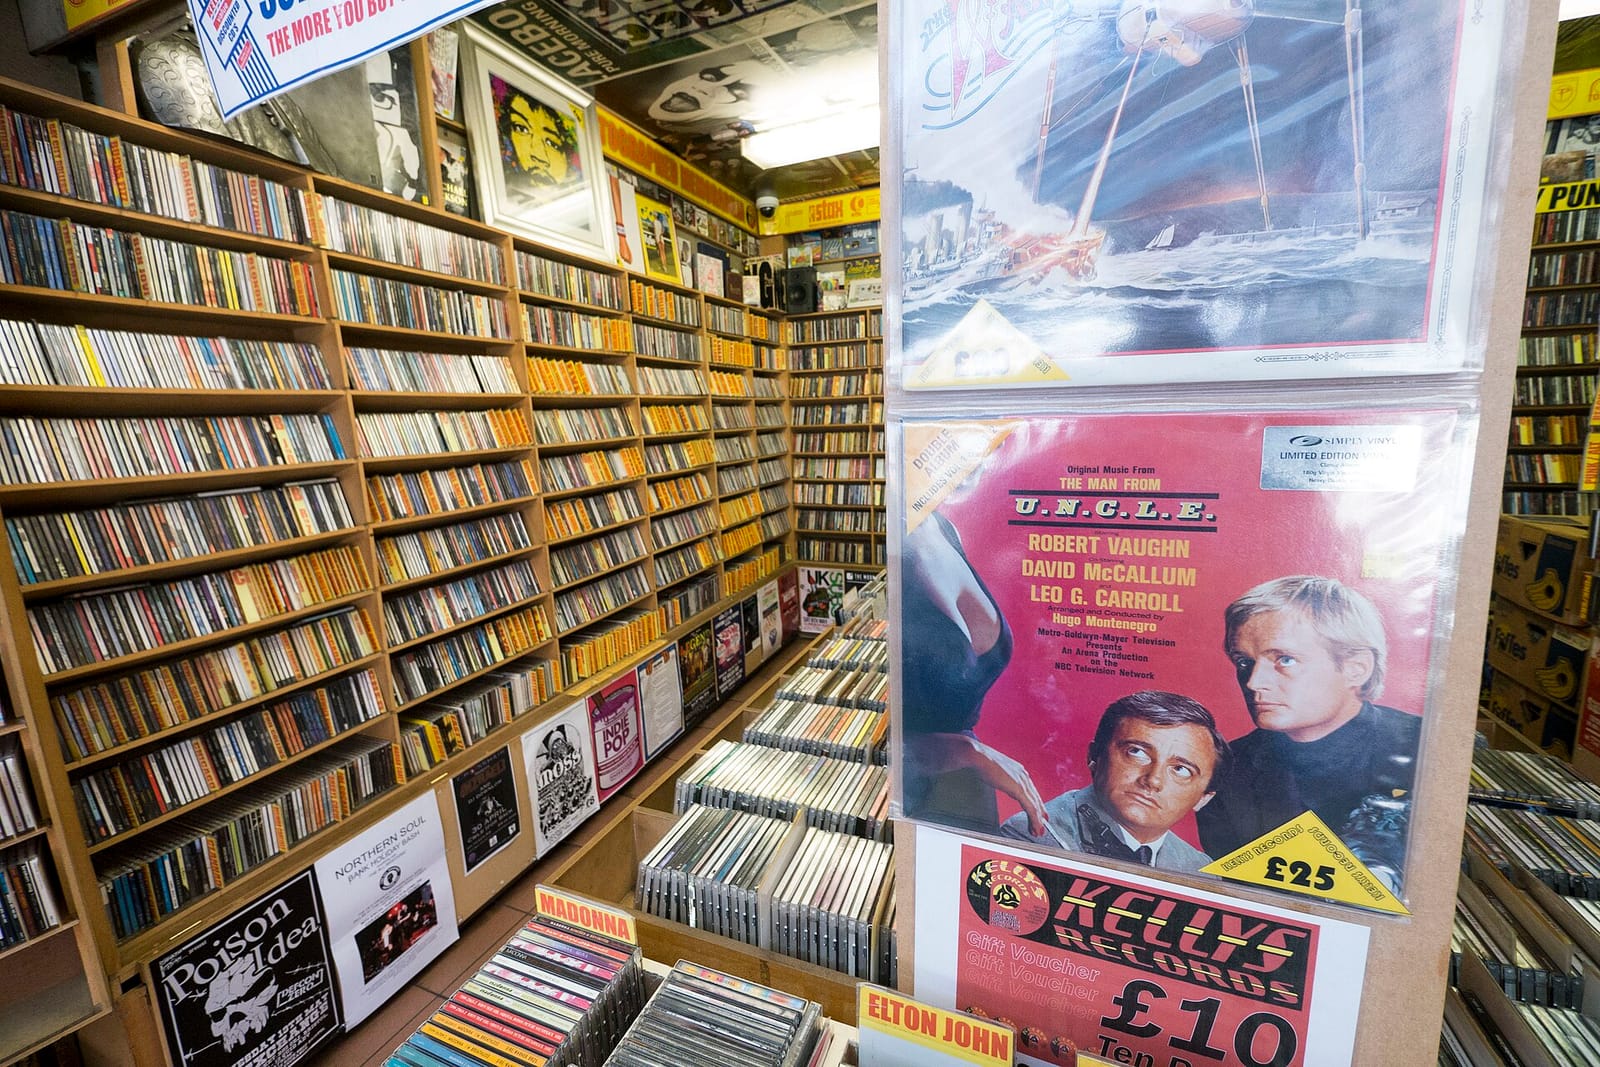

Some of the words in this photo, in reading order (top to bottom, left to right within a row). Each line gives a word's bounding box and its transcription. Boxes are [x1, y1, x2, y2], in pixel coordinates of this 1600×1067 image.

[266, 25, 291, 57] THE
[291, 8, 332, 47] MORE
[333, 0, 364, 30] YOU
[521, 1, 591, 51] MORNING
[583, 48, 620, 73] PURE
[178, 160, 199, 217] BANGLES
[246, 179, 266, 232] BOYZONE
[912, 428, 953, 470] DOUBLE
[924, 439, 961, 477] ALBUM
[1280, 452, 1317, 460] LIMITED
[1321, 452, 1359, 460] EDITION
[1059, 478, 1082, 489] THE
[1088, 478, 1117, 490] MAN
[1124, 479, 1160, 490] FROM
[1067, 466, 1099, 475] Original
[1103, 466, 1129, 474] Music
[912, 477, 948, 512] INCLUDES
[1015, 498, 1217, 521] U.N.C.L.E.
[1029, 534, 1100, 554] ROBERT
[1108, 537, 1190, 558] VAUGHN
[1022, 559, 1075, 579] DAVID
[1084, 563, 1196, 586] McCALLUM
[1031, 585, 1062, 603] LEO
[1071, 588, 1088, 605] G.
[1095, 590, 1184, 612] CARROLL
[1048, 605, 1084, 614] Arranged
[1104, 610, 1152, 618] Conducted
[1052, 613, 1081, 626] Hugo
[1086, 615, 1157, 633] Montenegro
[1076, 648, 1098, 657] Arena
[1103, 651, 1148, 662] Production
[1086, 641, 1122, 651] Presents
[1133, 636, 1176, 646] Television
[1055, 662, 1071, 670] NBC
[1075, 665, 1116, 675] Television
[1120, 669, 1154, 679] Network
[603, 714, 630, 742] INDIE
[604, 727, 631, 758] POP
[335, 833, 398, 880] NORTHERN
[399, 815, 427, 838] SOUL
[347, 864, 369, 883] BANK
[370, 843, 401, 867] HOLIDAY
[401, 830, 421, 847] BASH
[1252, 824, 1304, 856] RECORDS
[1307, 826, 1355, 872] RECORDS
[971, 861, 1047, 903] KELLYS
[985, 874, 1030, 898] RECORDS
[1263, 856, 1336, 891] £25
[539, 892, 631, 940] MADONNA
[161, 899, 293, 1005] Poison
[250, 916, 321, 972] Idea
[966, 931, 1005, 955] Gift
[1011, 944, 1100, 982] Voucher
[966, 949, 1005, 974] Gift
[1010, 962, 1099, 1001] Voucher
[1054, 924, 1298, 1004] RECORDS
[279, 972, 320, 998] DEFCON
[288, 983, 314, 1001] ZERO
[1009, 981, 1097, 1019] Voucher
[869, 993, 937, 1038] ELTON
[943, 1016, 1008, 1061] JOHN
[1101, 979, 1297, 1067] £10
[1099, 1035, 1154, 1067] Ten
